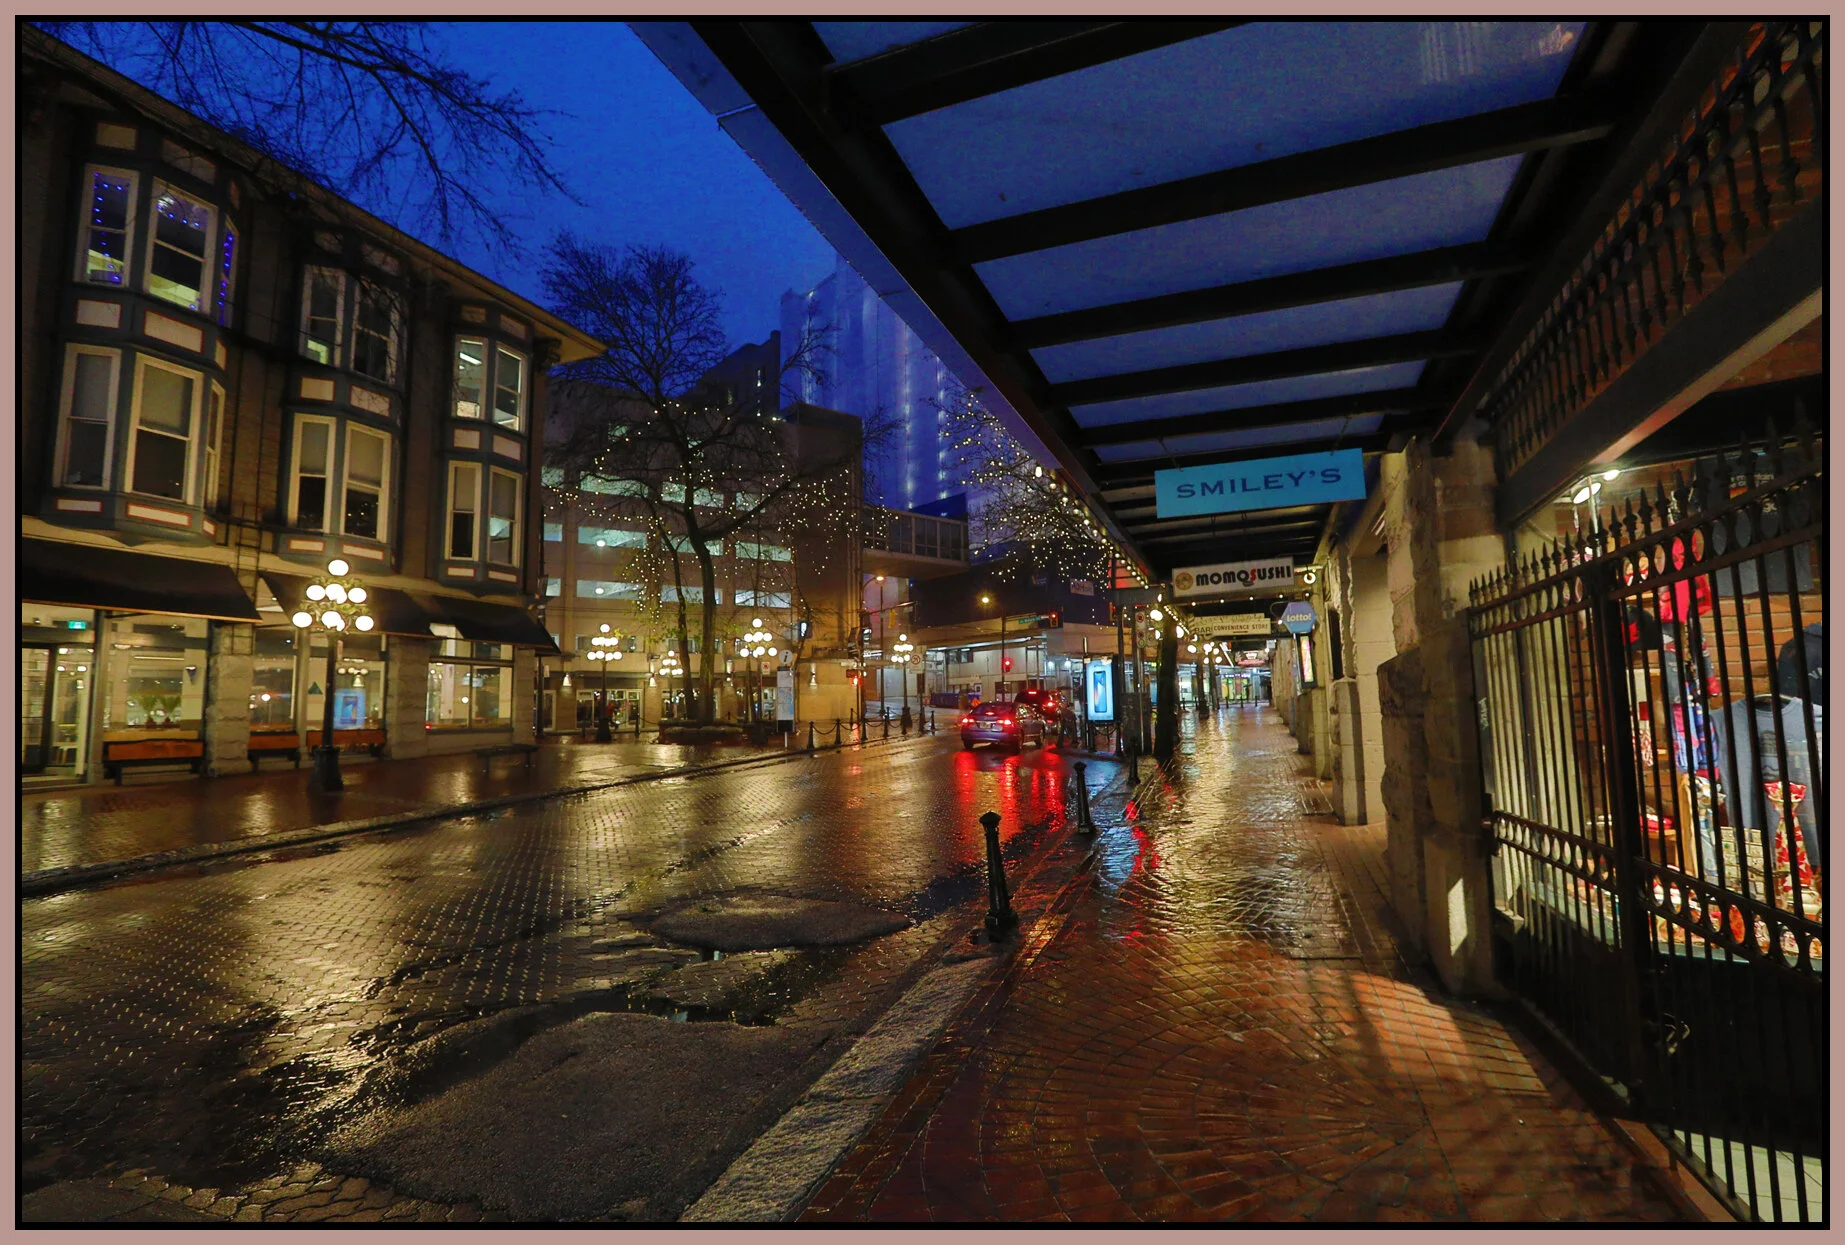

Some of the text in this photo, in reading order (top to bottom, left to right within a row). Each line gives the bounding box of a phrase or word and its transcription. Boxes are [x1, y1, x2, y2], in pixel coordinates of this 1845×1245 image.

[1176, 468, 1342, 499] SMILEY'S
[1213, 622, 1268, 631] CONVENIENCE STORE
